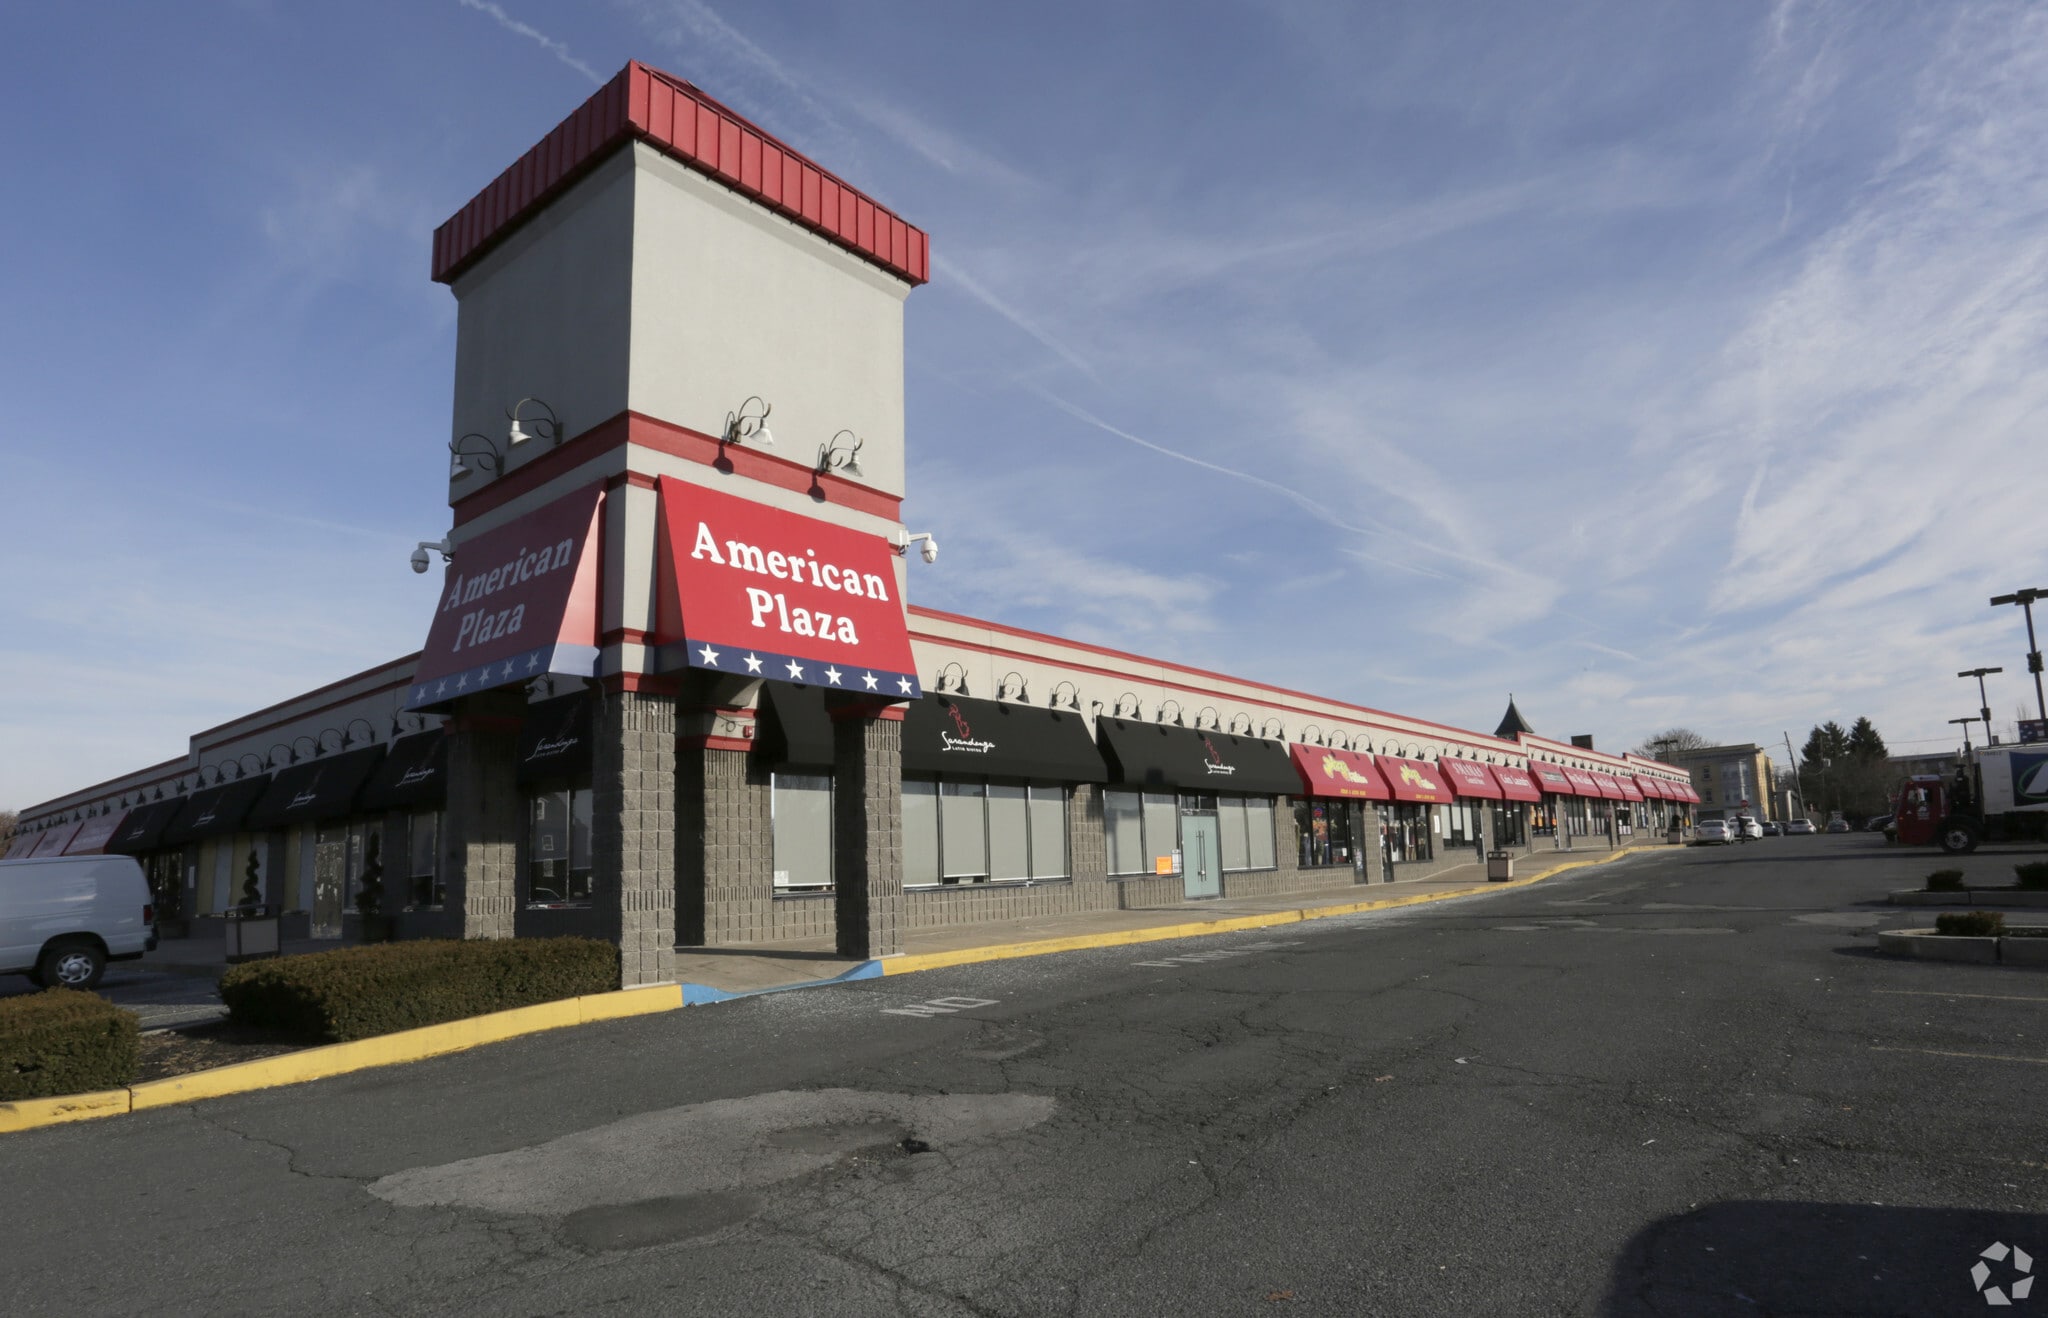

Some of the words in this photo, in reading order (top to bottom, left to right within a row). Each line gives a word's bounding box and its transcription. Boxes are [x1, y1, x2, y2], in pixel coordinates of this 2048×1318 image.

[443, 536, 574, 613] American
[691, 522, 889, 602] American
[452, 602, 526, 653] Plaza
[745, 587, 859, 646] Plaza
[878, 996, 1001, 1018] NO
